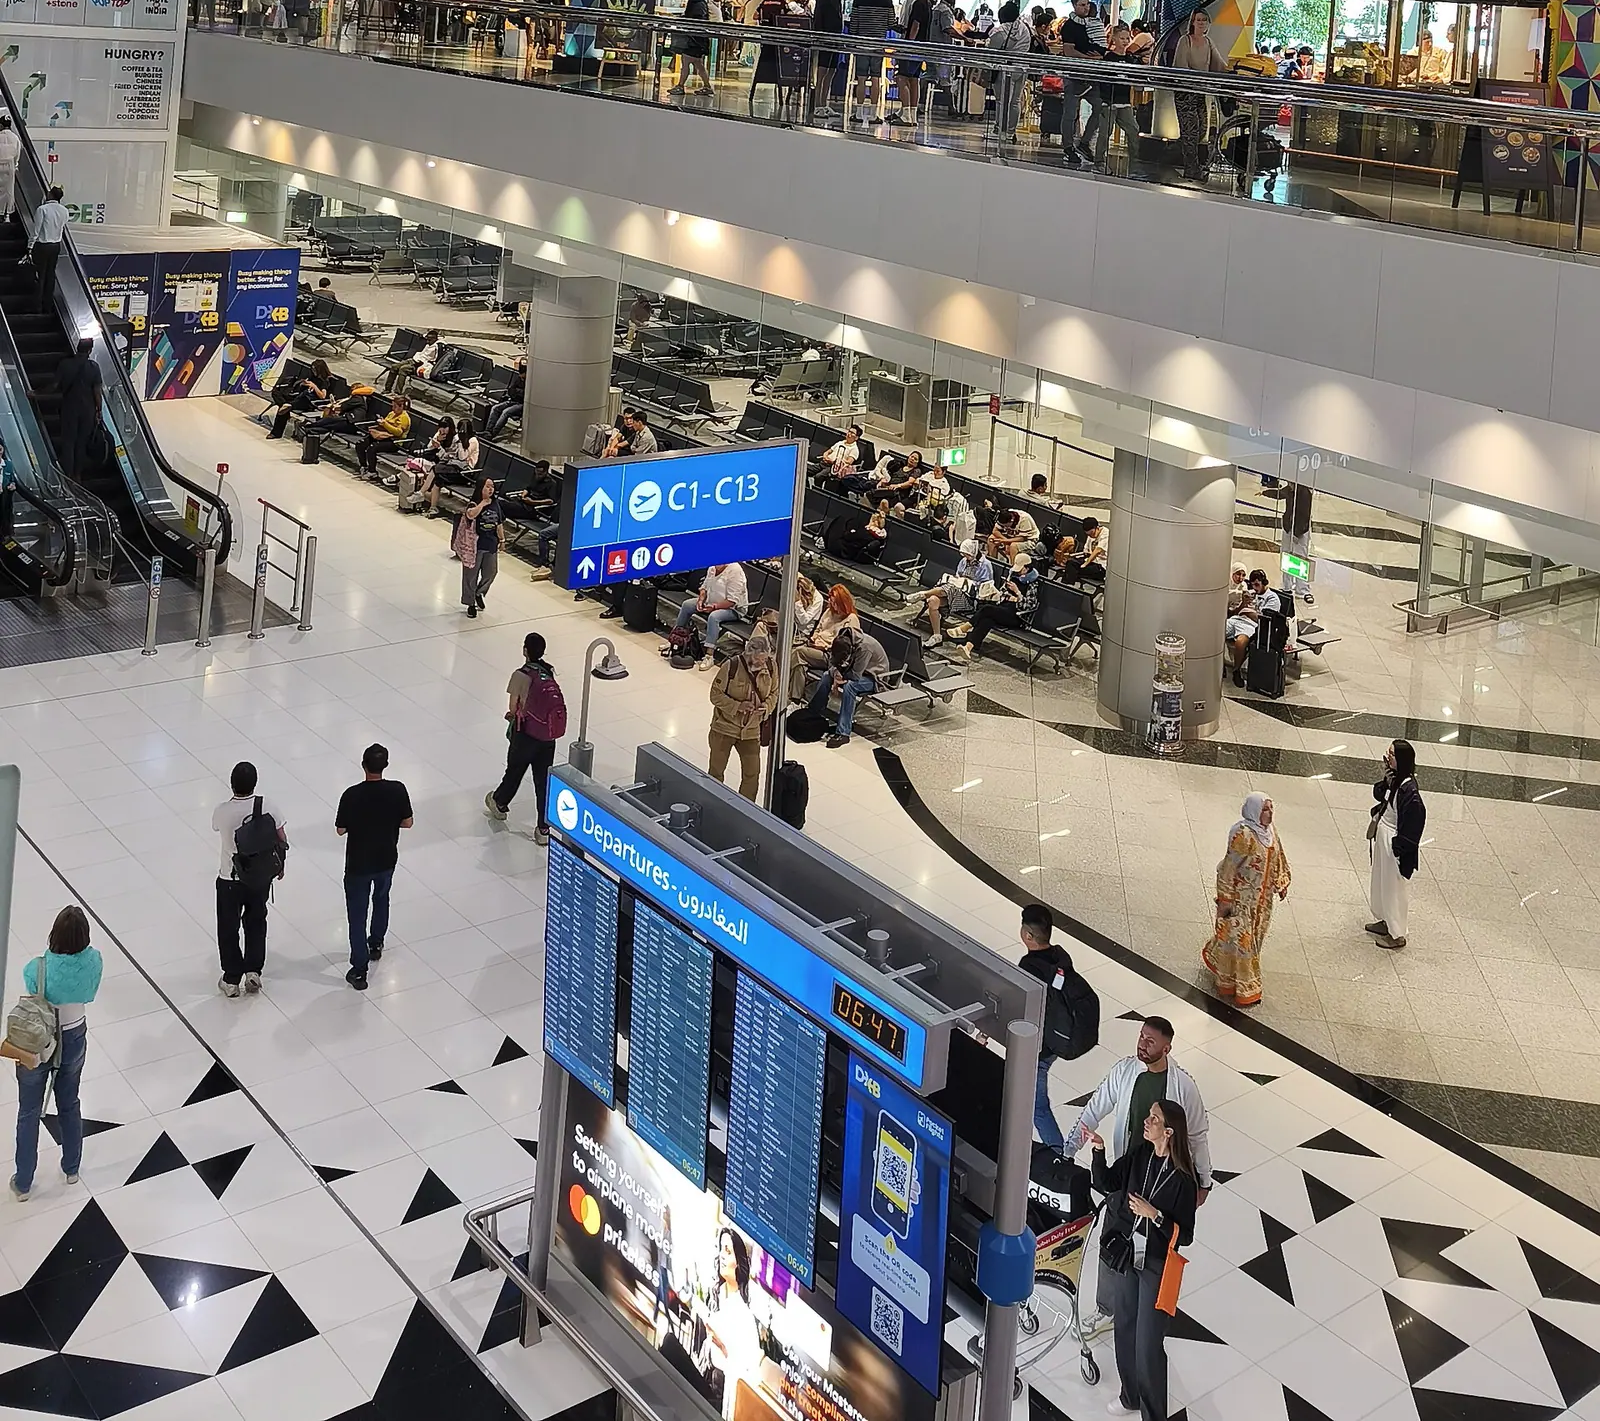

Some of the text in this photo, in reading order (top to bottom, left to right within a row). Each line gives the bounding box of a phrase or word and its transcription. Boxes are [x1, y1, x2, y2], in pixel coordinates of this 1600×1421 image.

[46, 0, 78, 8] +stone
[145, 6, 167, 15] INDIA
[104, 48, 164, 60] HUNGRY?
[96, 203, 106, 223] DXB
[668, 473, 760, 511] C1-C13
[838, 991, 898, 1050] 06:47
[593, 1078, 610, 1098] 06:47
[575, 1124, 617, 1178] Setting
[682, 1158, 700, 1180] 06:47
[572, 1150, 586, 1173] to
[587, 1166, 634, 1220] airplane
[603, 1222, 660, 1288] priceless
[787, 1253, 808, 1278] 06:47
[864, 1234, 916, 1283] Scan the QR code
[800, 1360, 822, 1386] your
